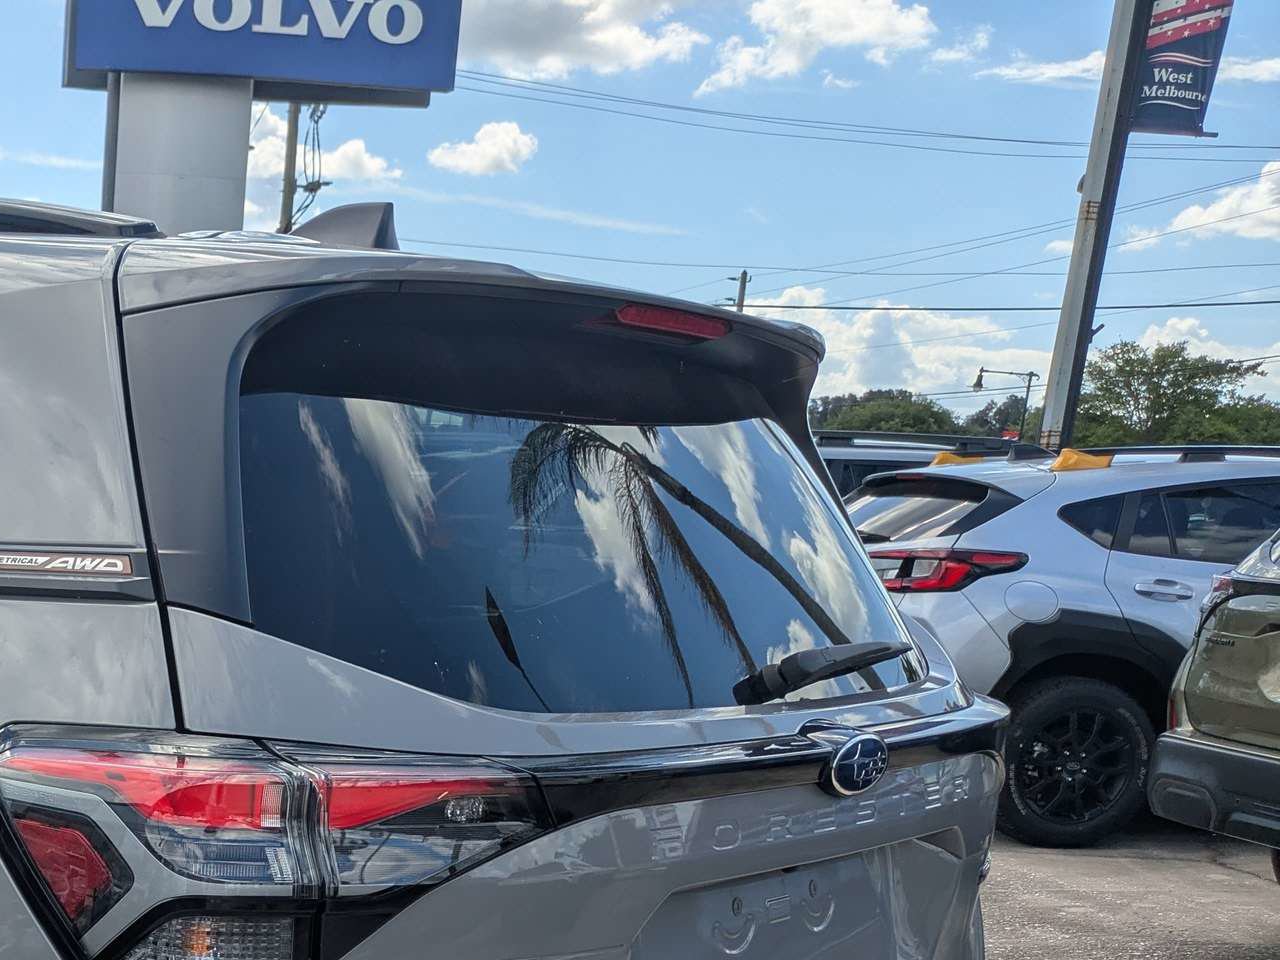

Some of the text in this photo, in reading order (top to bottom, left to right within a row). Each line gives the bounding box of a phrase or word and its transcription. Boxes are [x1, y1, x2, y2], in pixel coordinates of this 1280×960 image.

[133, 0, 424, 45] VOLVO
[1152, 67, 1194, 84] West
[44, 556, 124, 572] AWD
